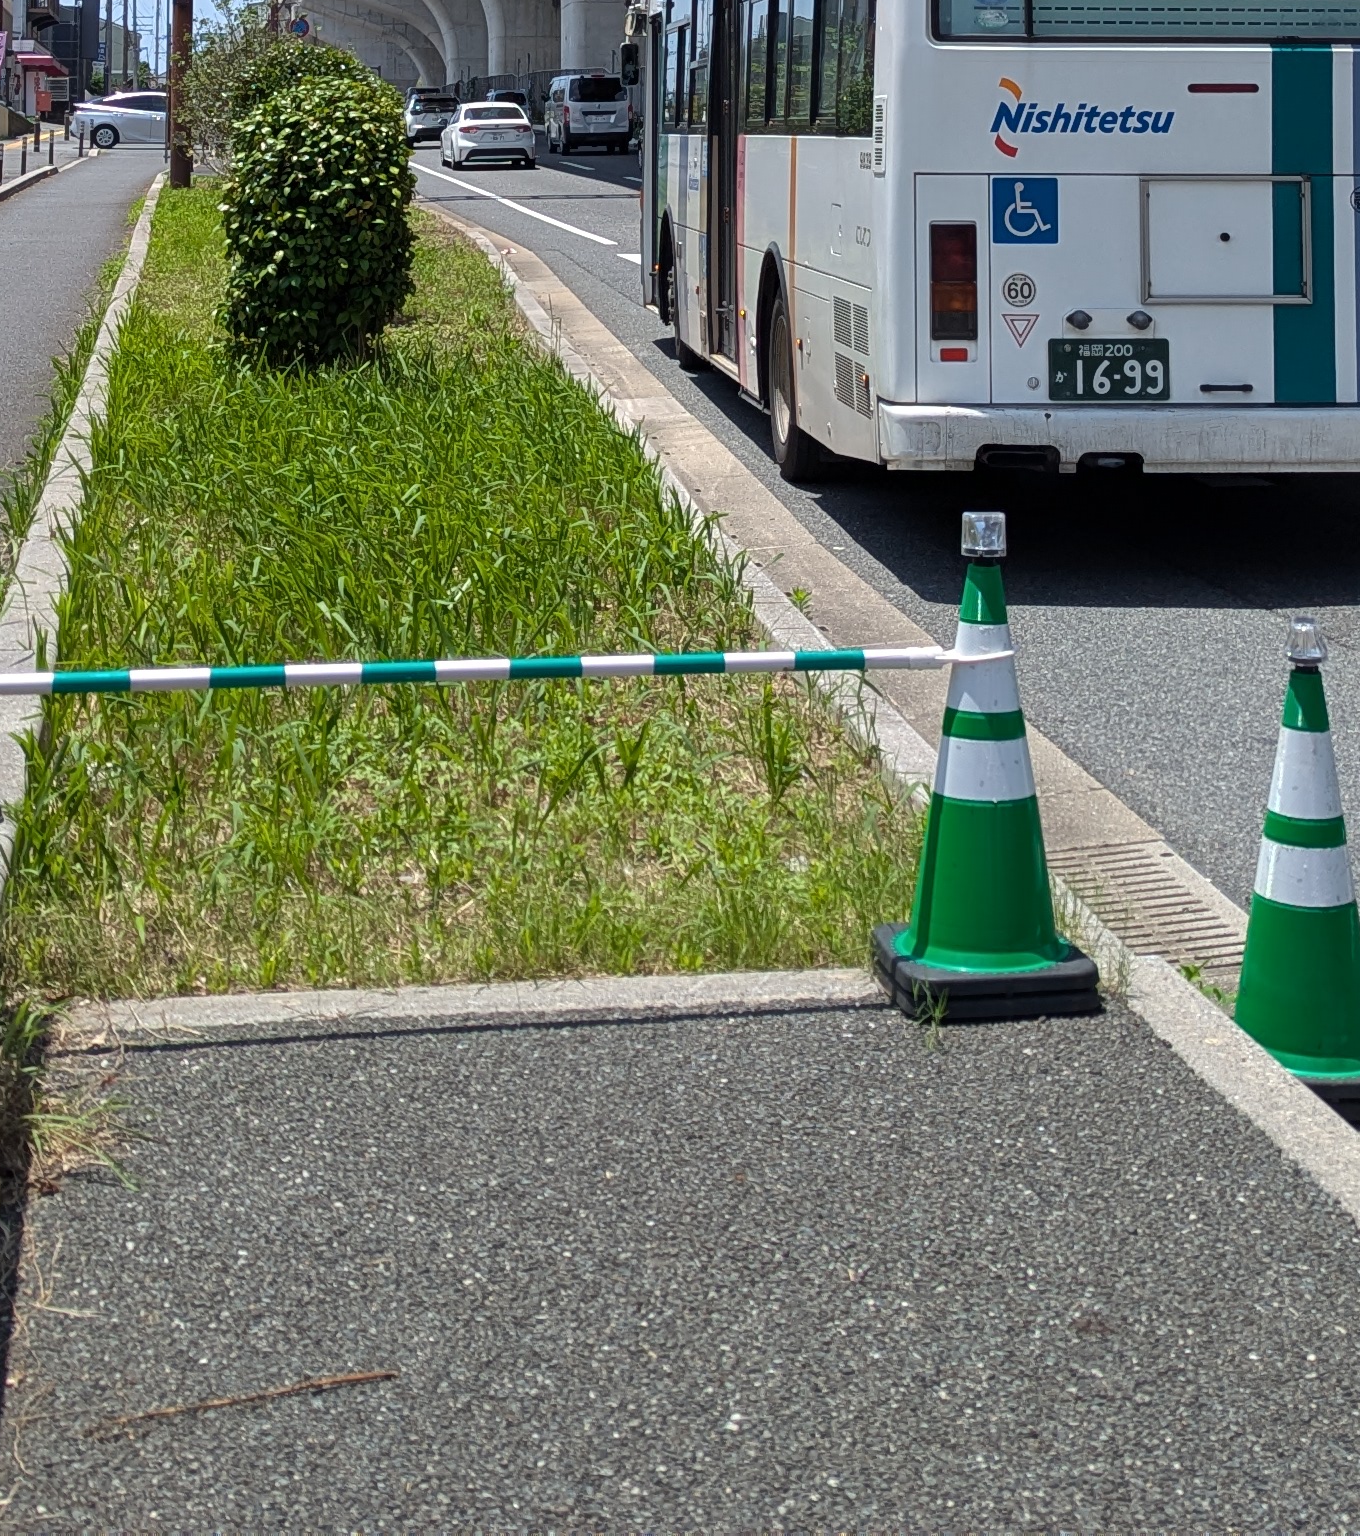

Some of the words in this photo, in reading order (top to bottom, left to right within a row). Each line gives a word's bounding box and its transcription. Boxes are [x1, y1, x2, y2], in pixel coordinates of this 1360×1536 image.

[990, 101, 1175, 134] Nishitetsu
[1007, 281, 1032, 300] 60
[1054, 370, 1068, 384] か
[1076, 359, 1165, 395] 16-99
